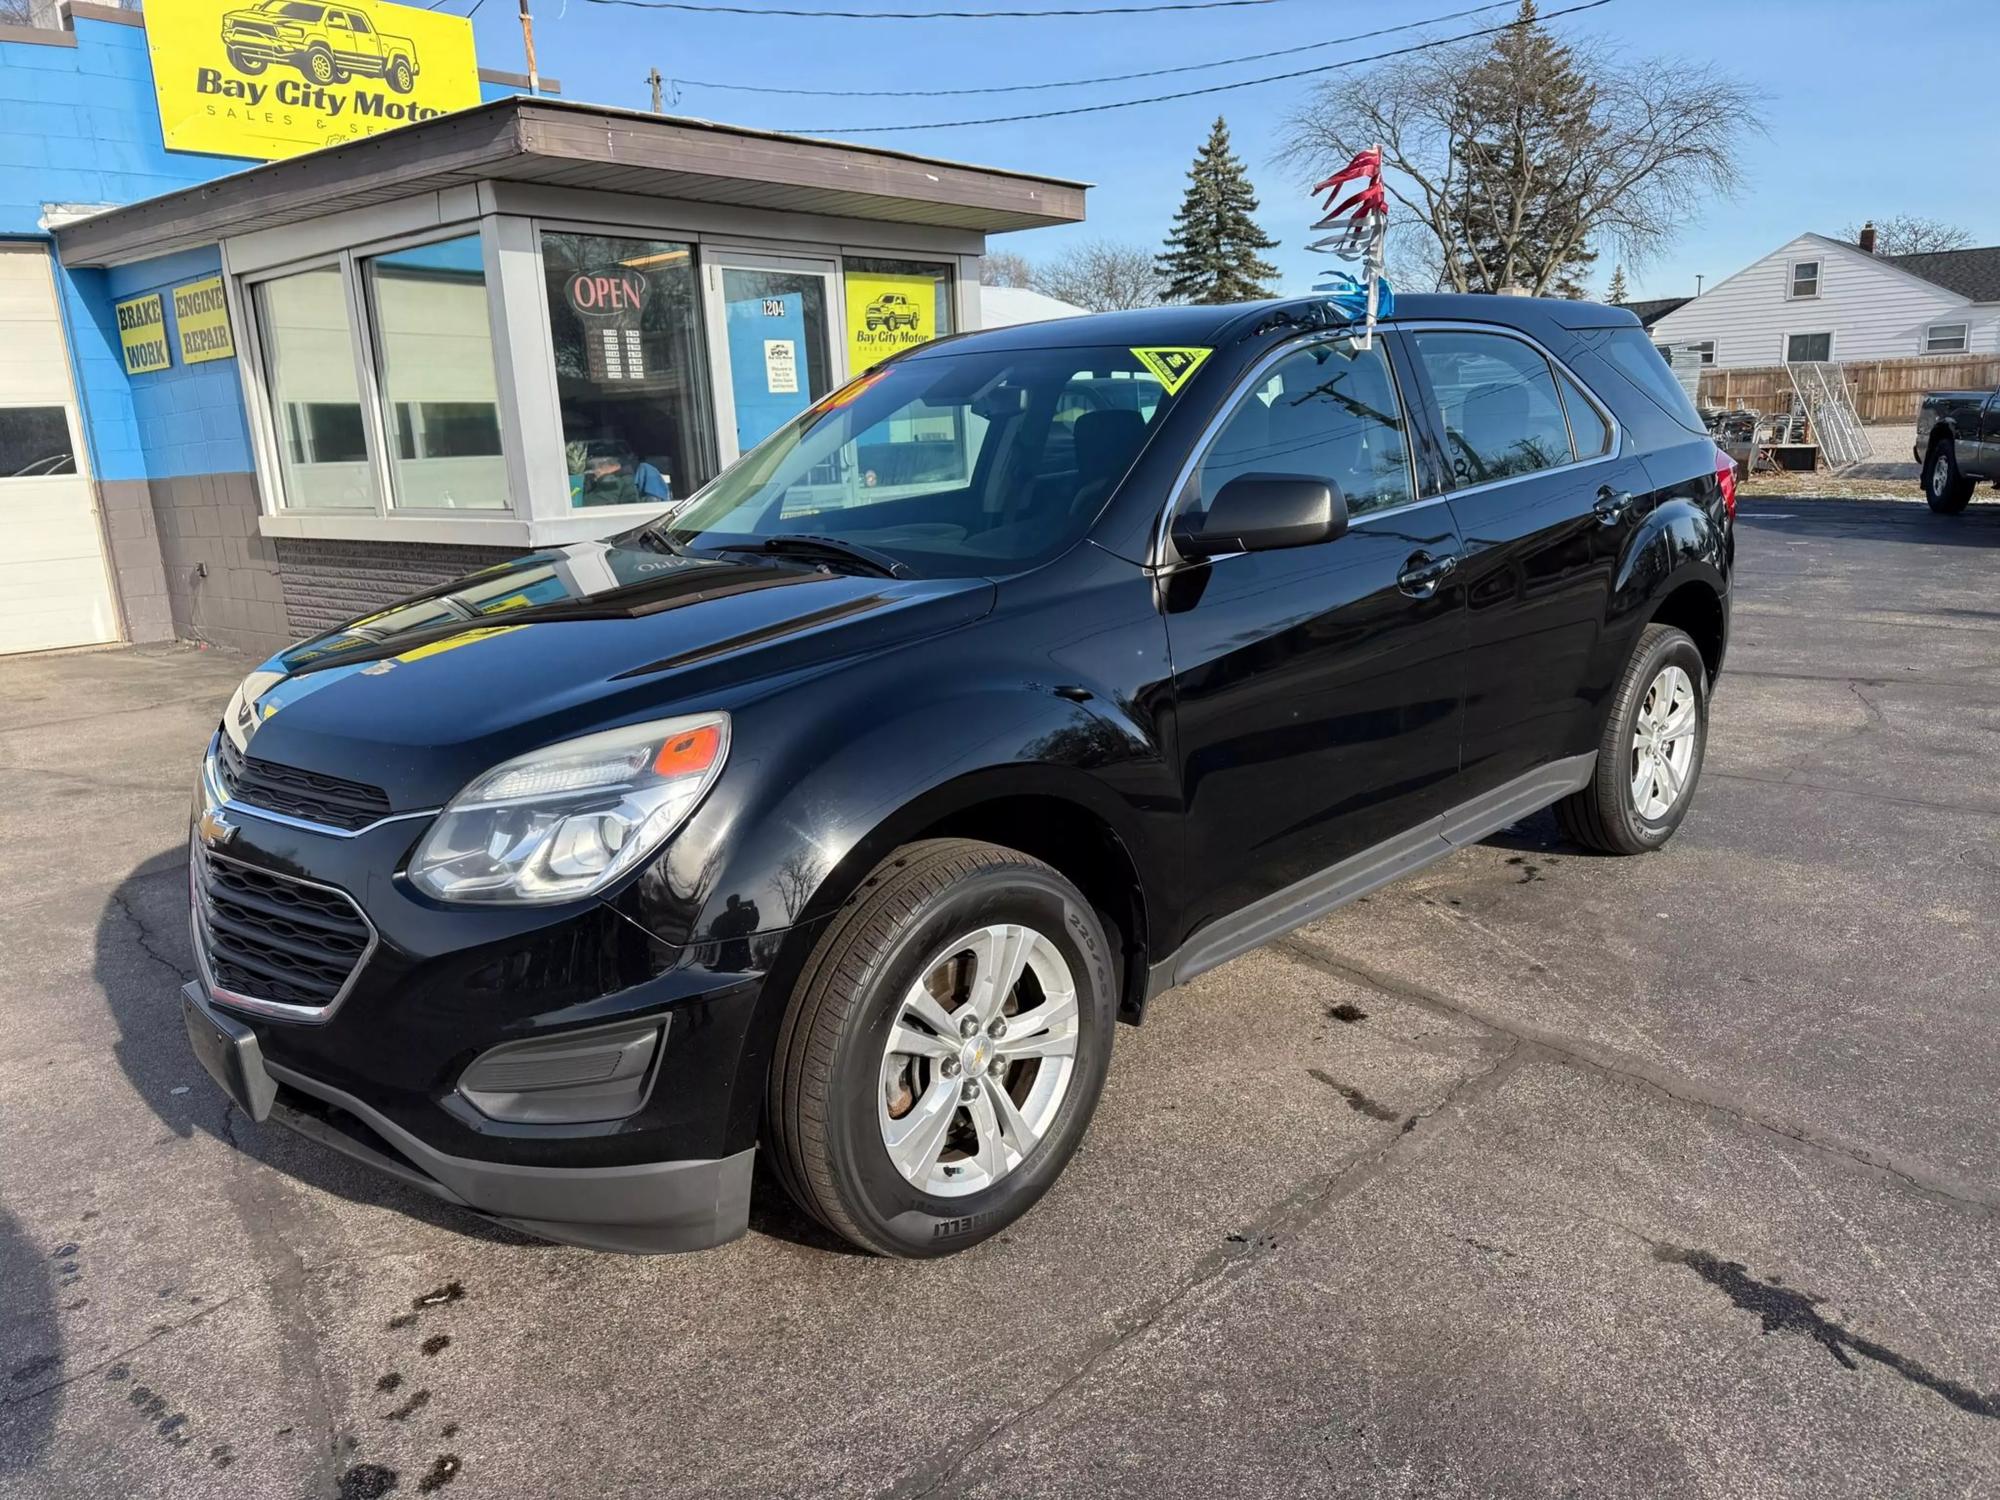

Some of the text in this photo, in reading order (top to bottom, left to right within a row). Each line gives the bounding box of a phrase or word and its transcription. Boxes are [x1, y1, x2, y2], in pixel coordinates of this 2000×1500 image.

[197, 67, 447, 122] Bay City Moto
[206, 105, 293, 126] SALES
[316, 119, 327, 129] &
[175, 286, 224, 318] ENGINE
[574, 276, 640, 309] OPEN
[118, 299, 161, 331] BRAKE
[762, 300, 785, 316] 1204
[183, 325, 229, 354] REPAIR
[857, 330, 877, 345] Bay
[878, 330, 899, 346] City
[126, 340, 166, 369] WORK
